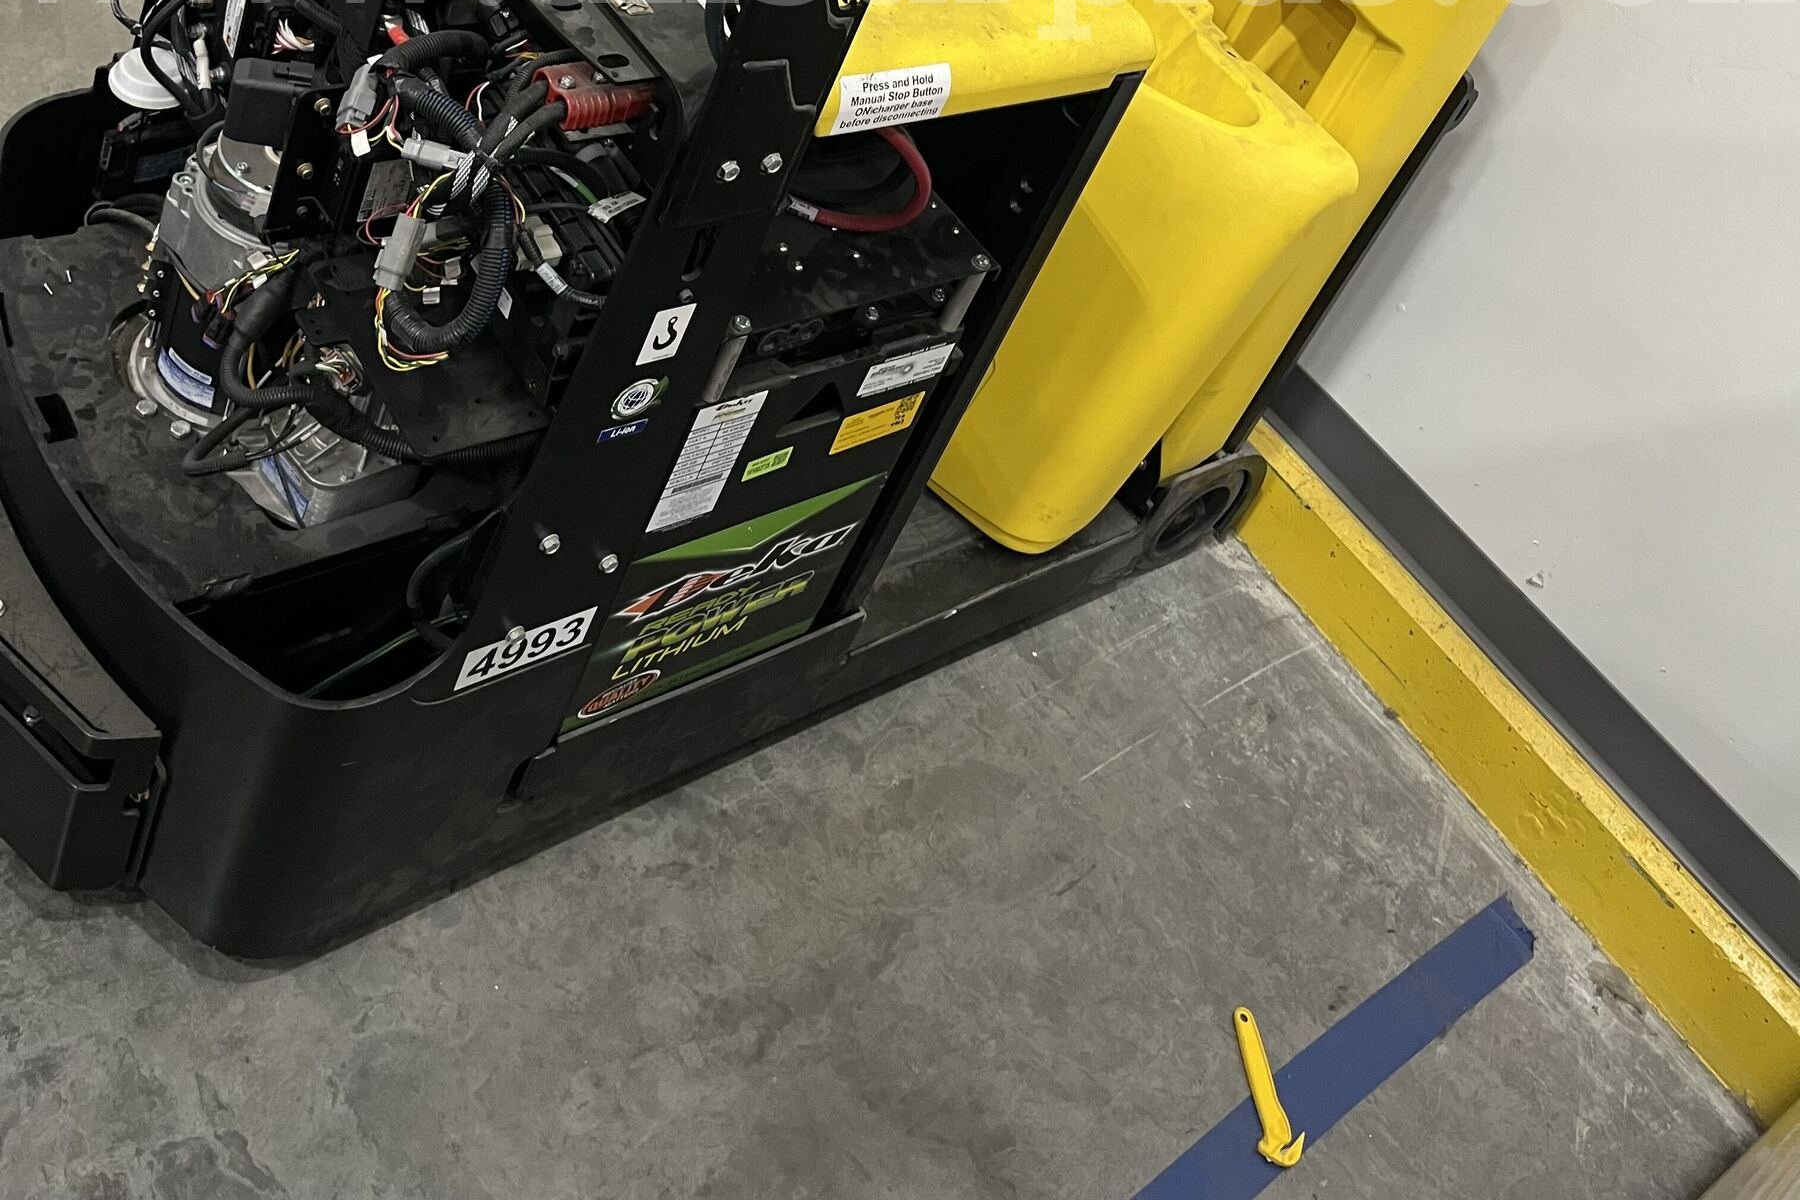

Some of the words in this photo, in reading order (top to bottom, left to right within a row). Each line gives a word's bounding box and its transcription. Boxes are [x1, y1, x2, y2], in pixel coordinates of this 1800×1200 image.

[851, 95, 886, 107] Manual
[888, 91, 911, 102] Stop
[912, 86, 943, 98] Button
[862, 81, 890, 93] Press
[892, 78, 910, 89] and
[912, 73, 934, 86] Hold
[910, 99, 934, 108] base
[840, 117, 870, 128] before
[873, 106, 938, 123] disconnecting
[610, 521, 859, 624] Deka
[620, 570, 816, 663] POWER
[638, 580, 760, 637] READY
[466, 617, 586, 678] 4993
[611, 616, 748, 680] LITHIUM
